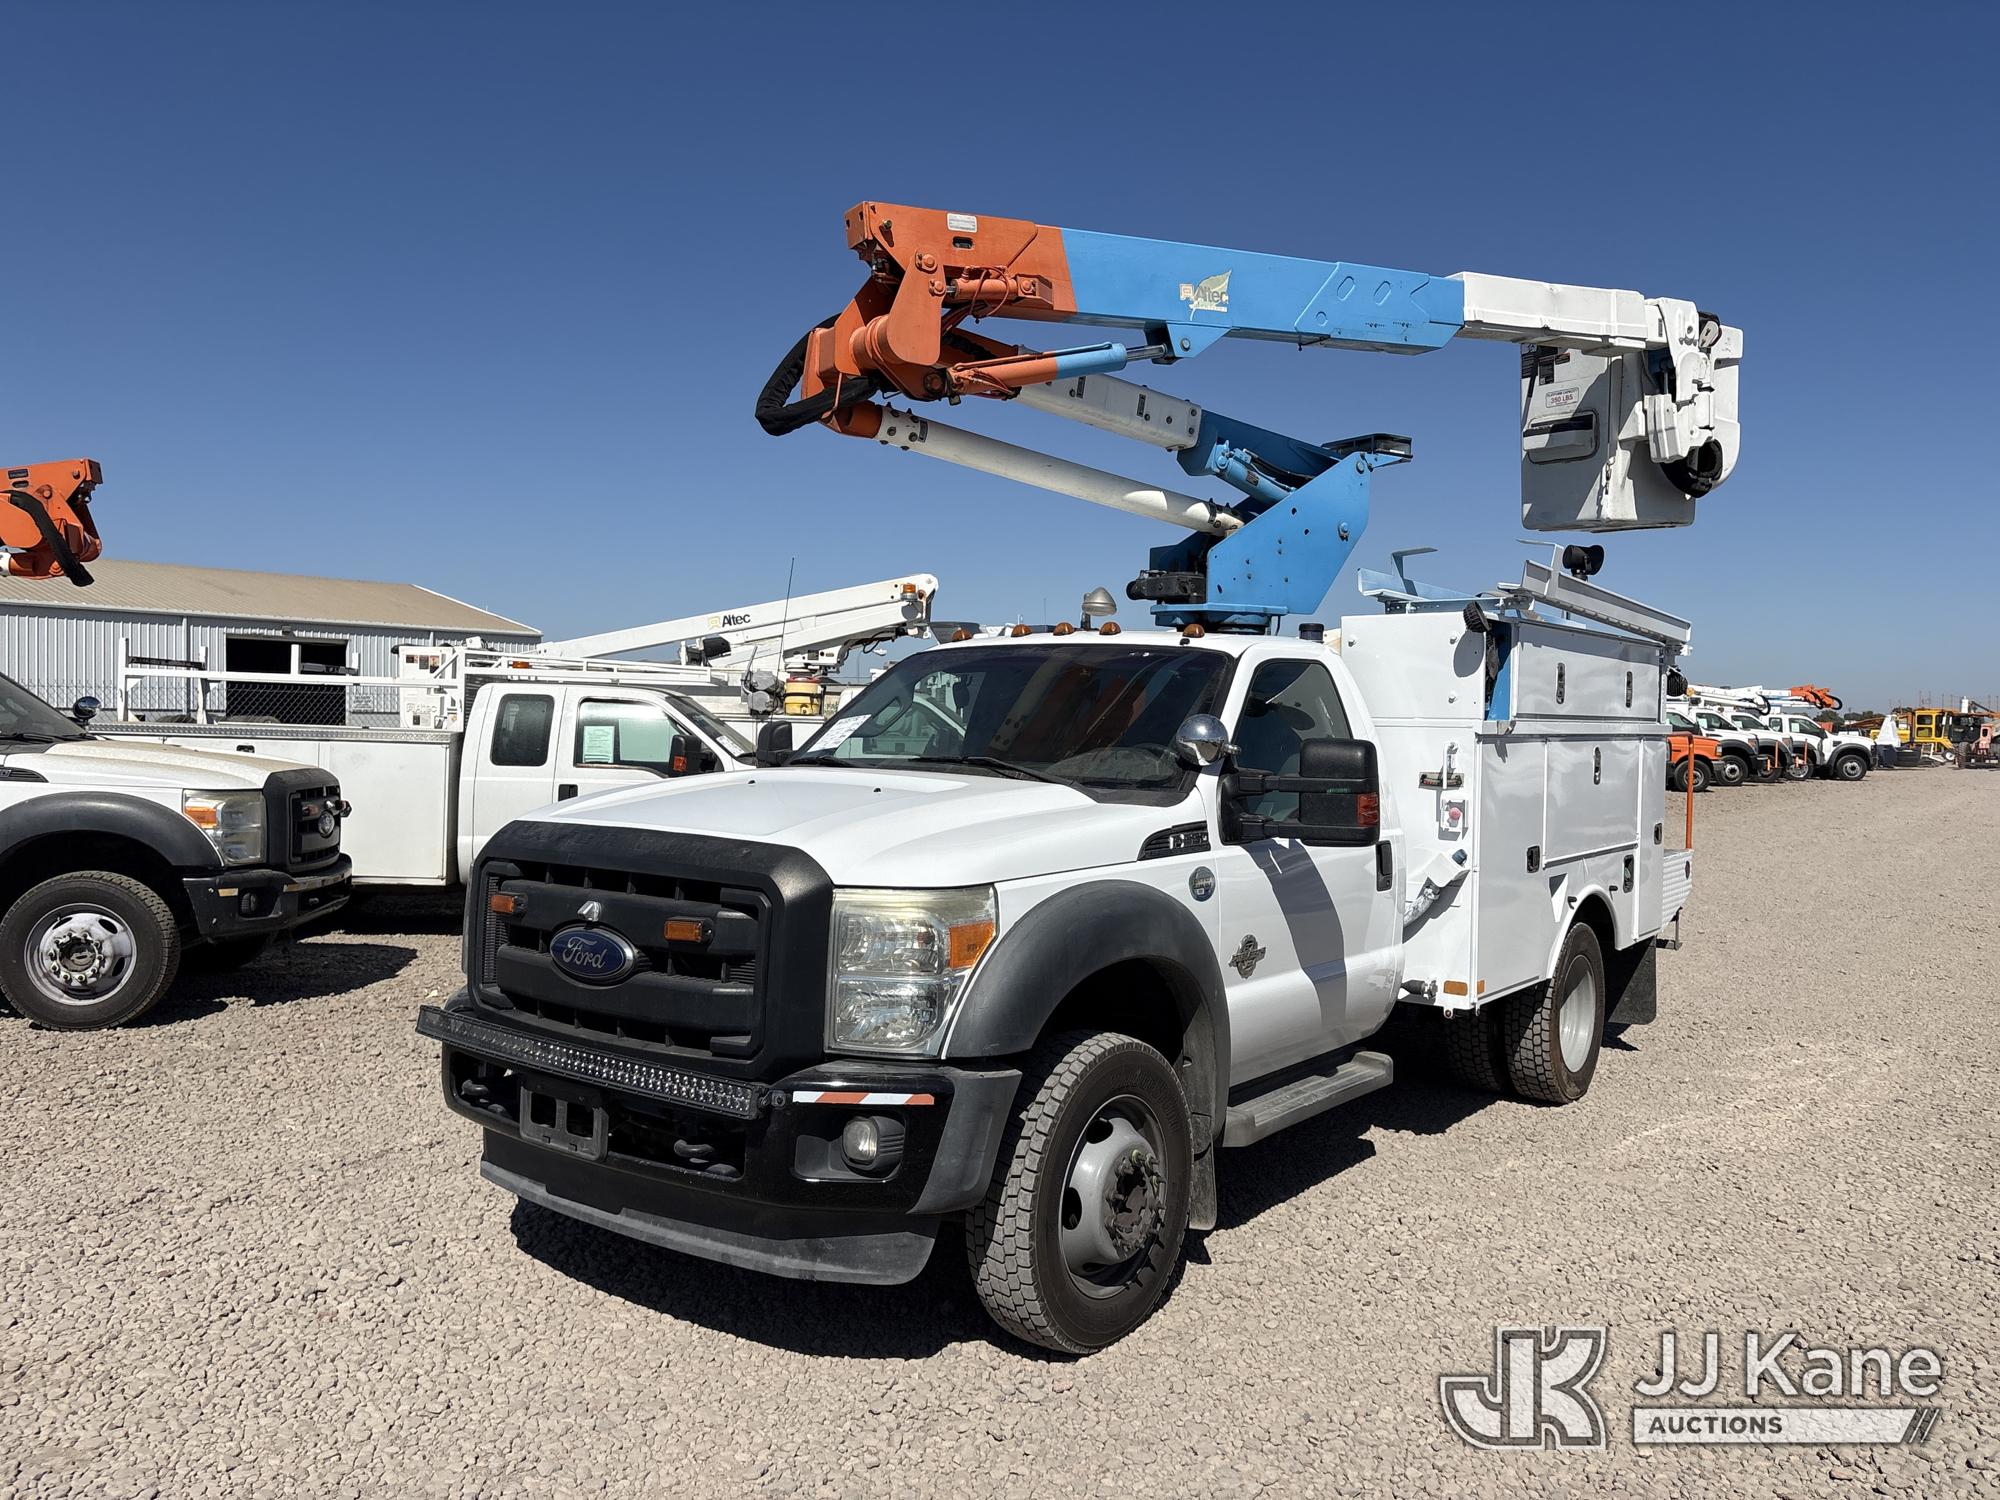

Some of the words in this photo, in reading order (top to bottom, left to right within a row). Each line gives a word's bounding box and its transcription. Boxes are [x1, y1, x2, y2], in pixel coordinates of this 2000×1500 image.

[1194, 286, 1228, 304] Altec
[1562, 394, 1574, 402] LBS
[722, 614, 751, 628] Altec
[562, 936, 607, 969] Ford
